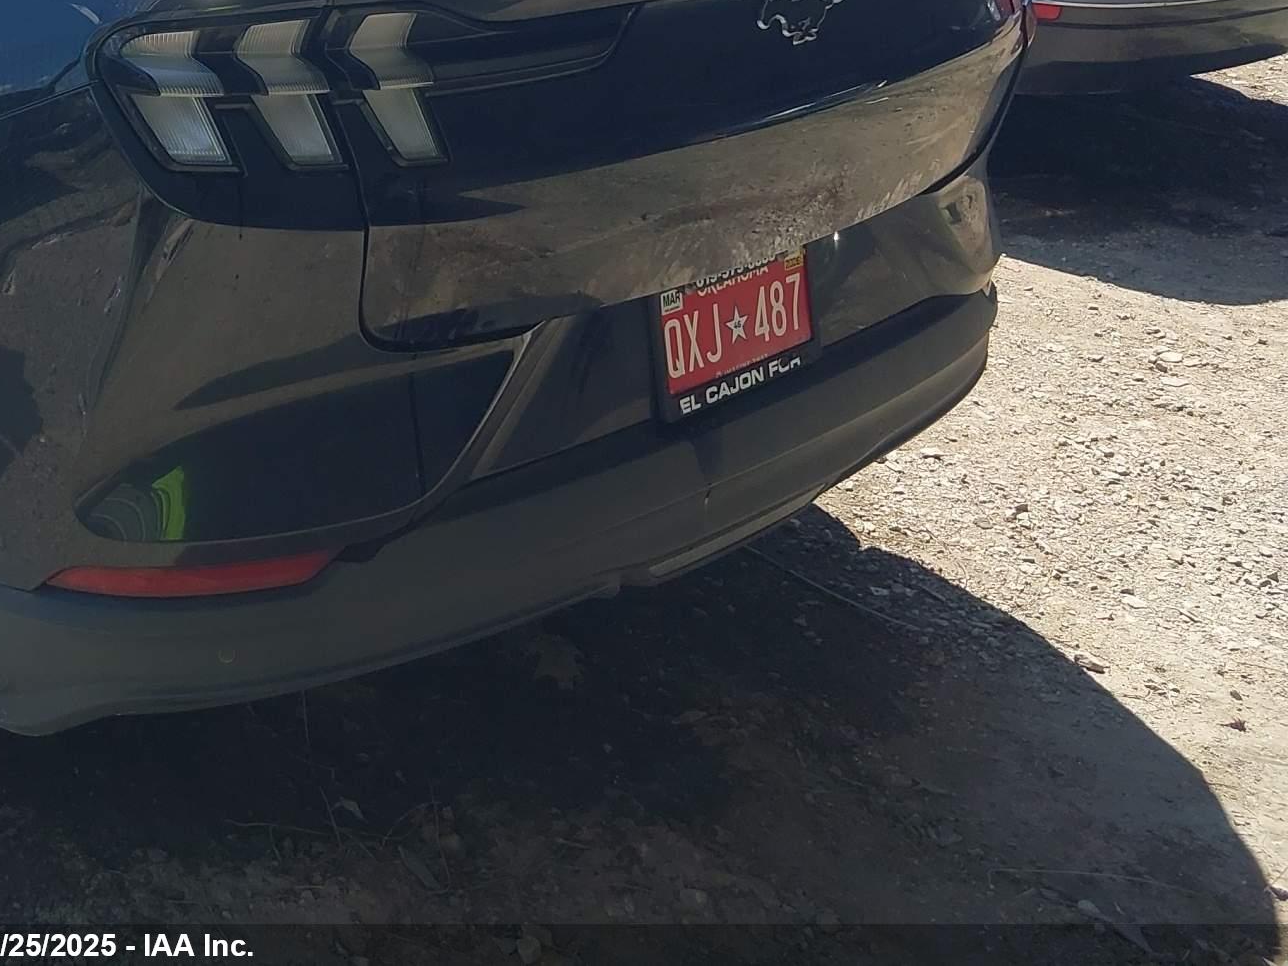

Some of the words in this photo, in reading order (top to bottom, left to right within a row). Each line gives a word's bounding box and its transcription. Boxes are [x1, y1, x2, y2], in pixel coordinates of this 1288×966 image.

[662, 290, 681, 307] MAR
[664, 303, 722, 379] QXJ
[755, 273, 801, 342] 487
[679, 394, 702, 415] EL
[706, 366, 765, 403] CAJON
